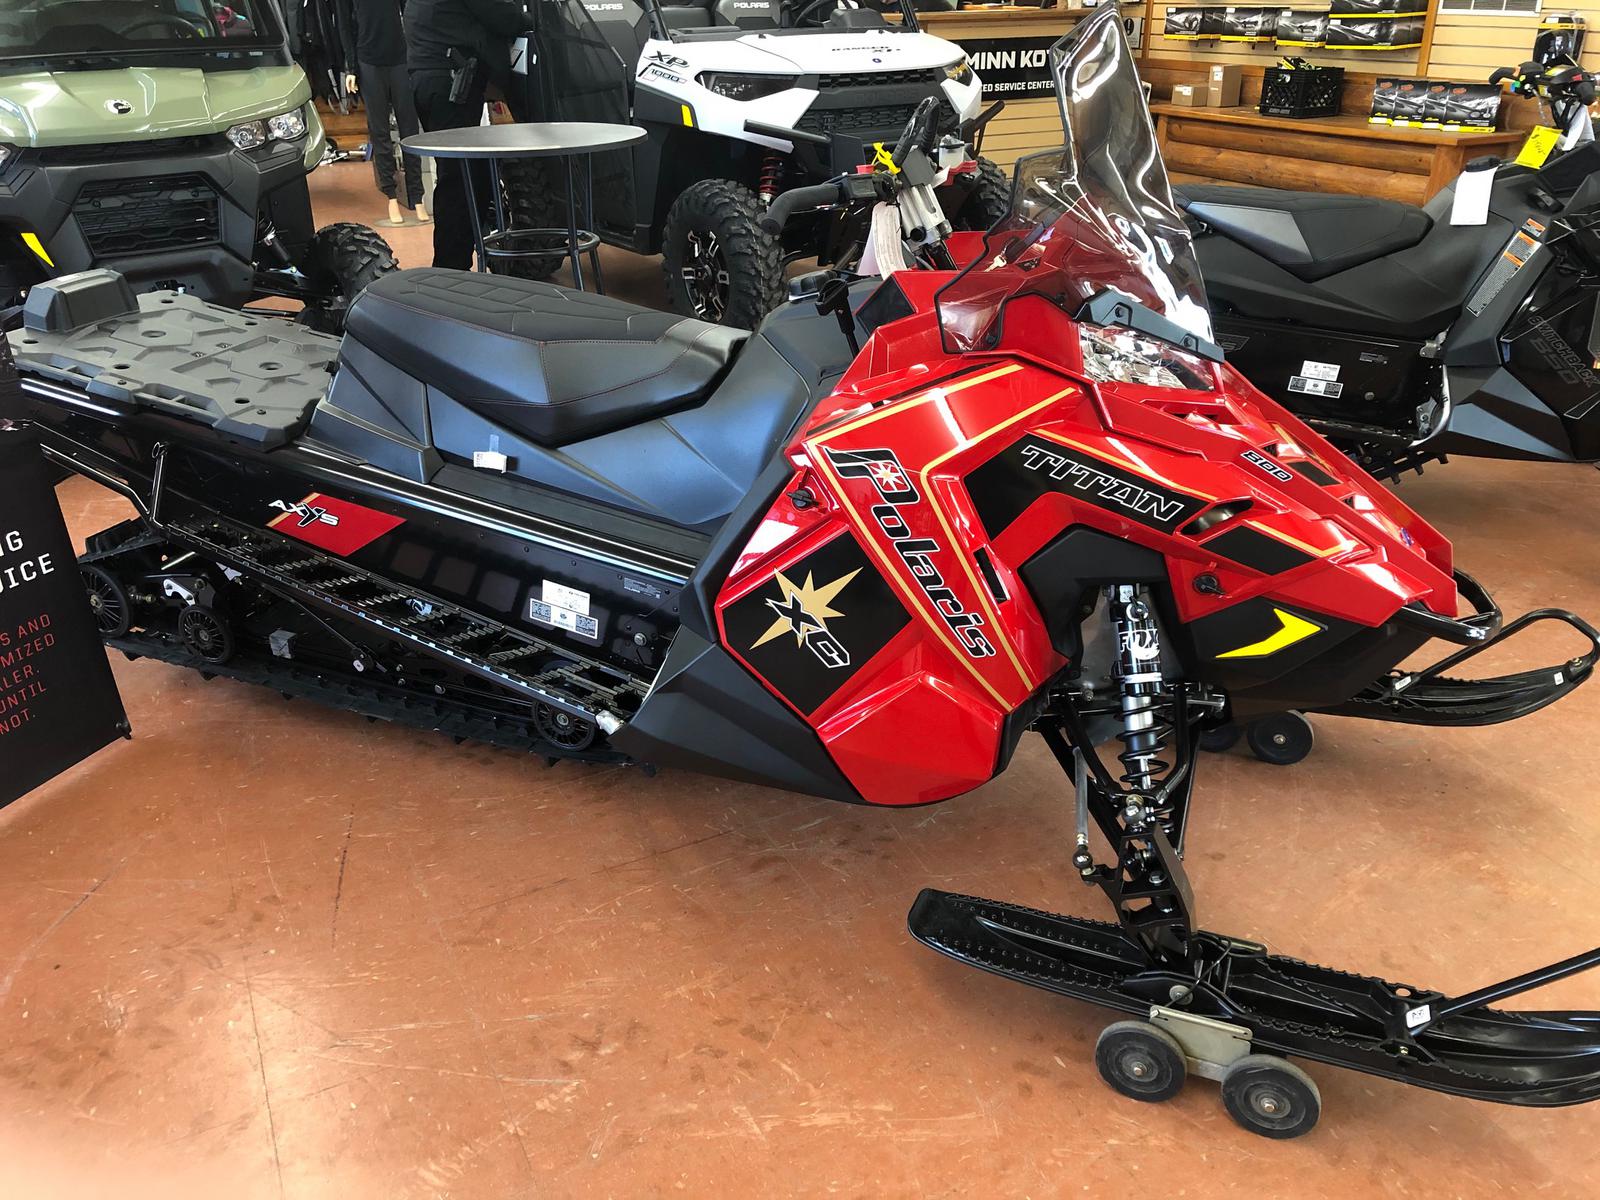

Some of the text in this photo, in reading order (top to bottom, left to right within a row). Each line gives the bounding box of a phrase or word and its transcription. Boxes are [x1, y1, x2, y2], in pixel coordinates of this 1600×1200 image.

[648, 51, 689, 67] XP
[965, 49, 1050, 70] MINN KO
[651, 69, 680, 82] 1000
[994, 82, 1026, 92] SERVICE
[1027, 80, 1055, 90] CENTER
[1529, 337, 1580, 385] 850
[1240, 450, 1293, 482] 800
[1021, 445, 1185, 522] TITAN
[822, 445, 997, 658] Polaris
[18, 614, 51, 639] AND
[765, 591, 850, 668] XC
[1118, 629, 1160, 658] FOX
